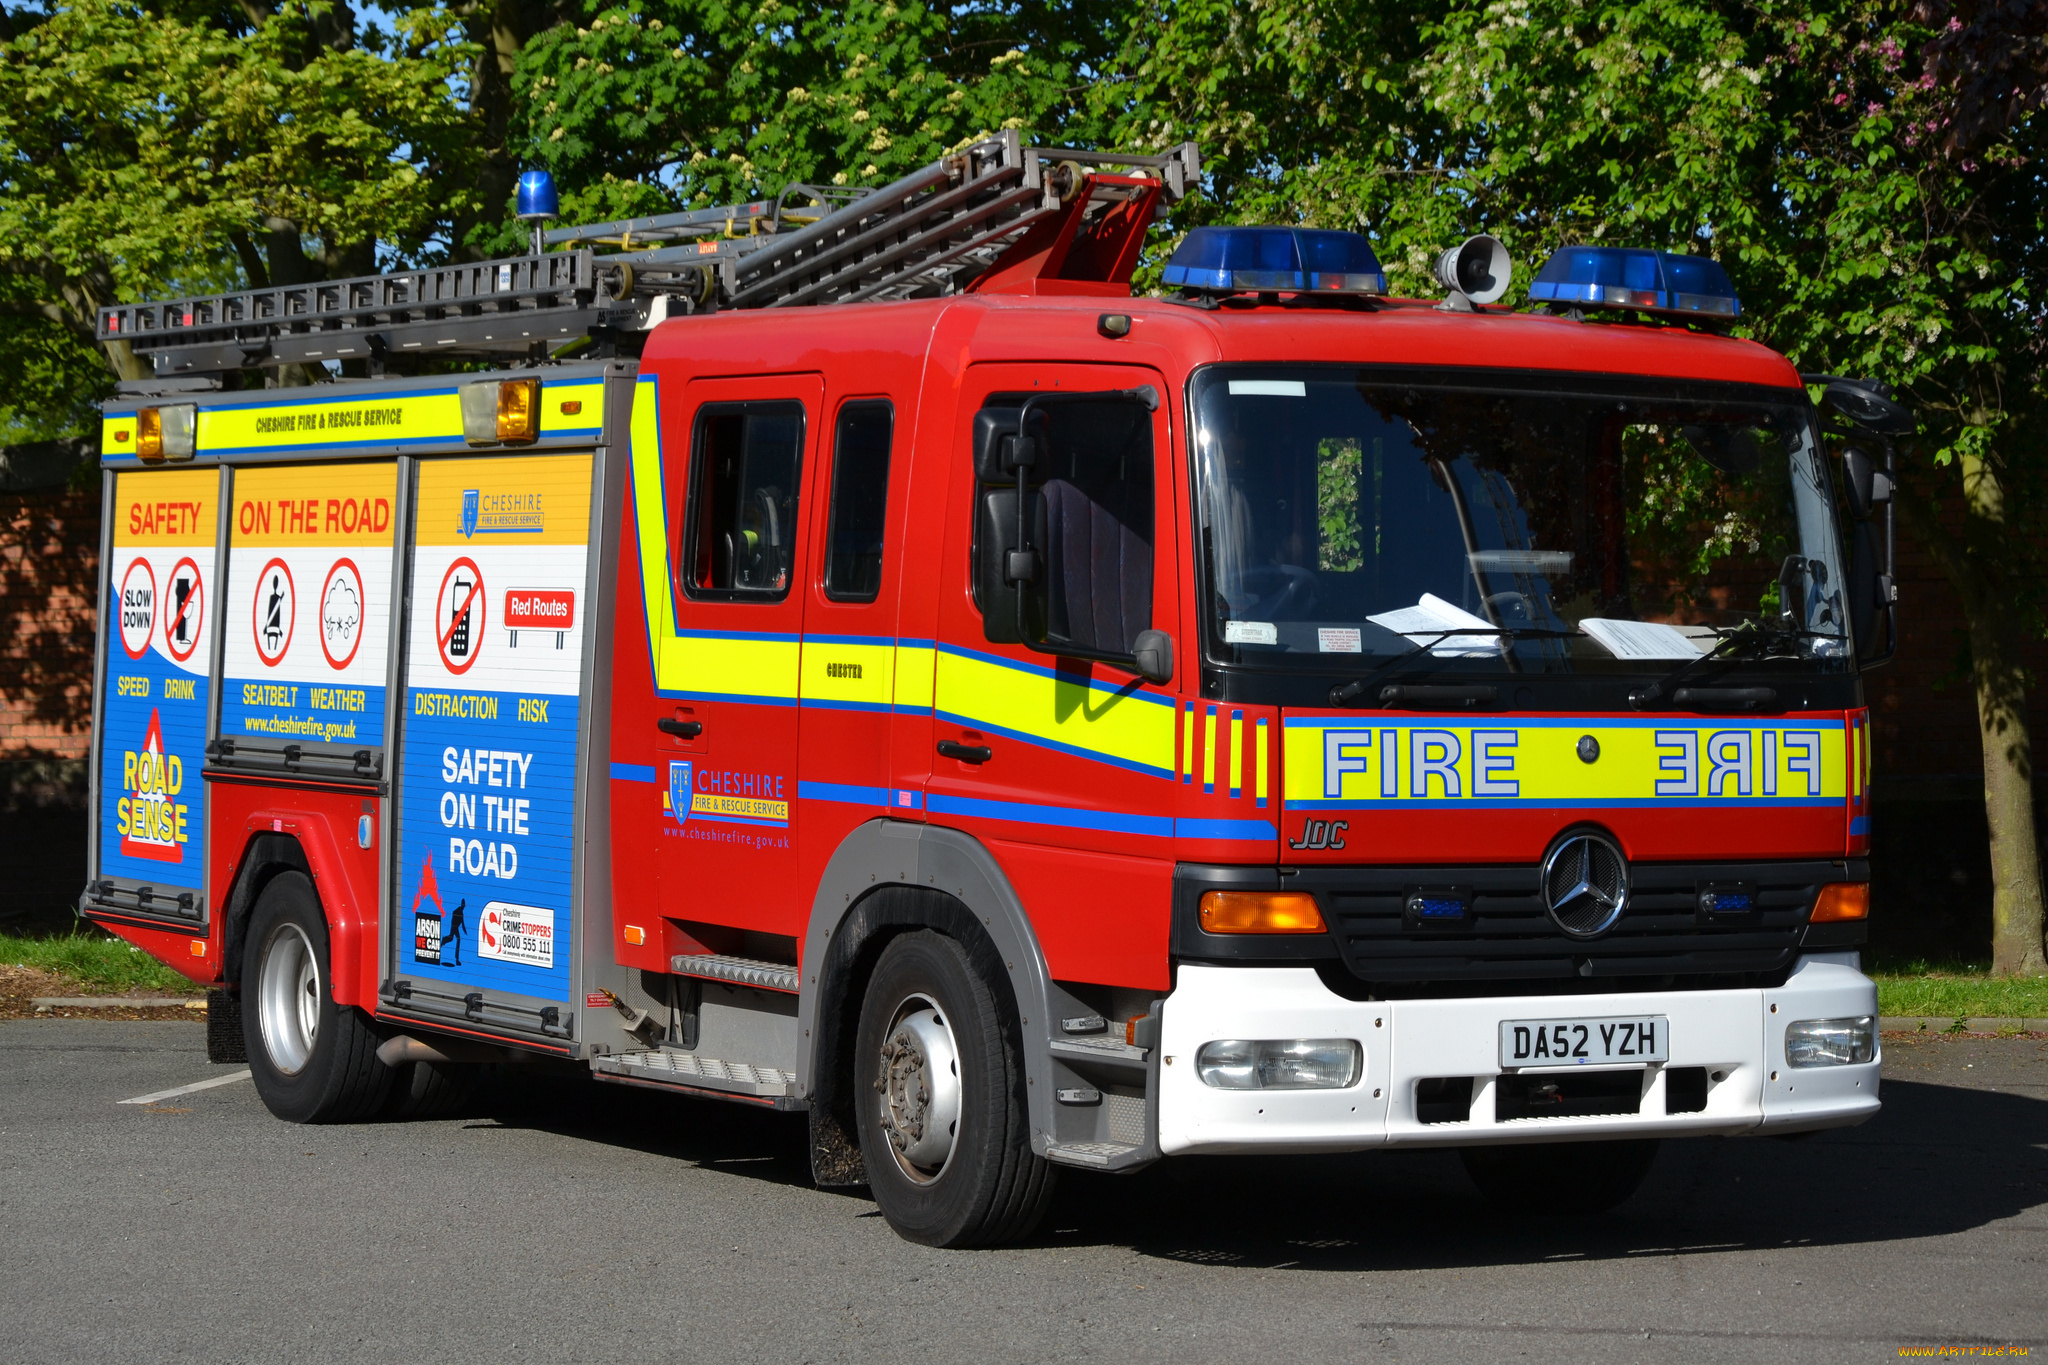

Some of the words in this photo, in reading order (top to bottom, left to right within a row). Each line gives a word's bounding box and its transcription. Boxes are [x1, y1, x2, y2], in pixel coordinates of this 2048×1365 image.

[256, 416, 296, 433] CHESHIRE
[298, 414, 316, 430] FIRE
[319, 413, 326, 429] &
[328, 410, 362, 428] RESCUE
[364, 408, 402, 426] SERVICE
[483, 494, 541, 511] CHESHIRE
[129, 502, 201, 535] SAFETY
[239, 501, 271, 535] ON
[278, 500, 318, 534] THE
[325, 498, 390, 534] ROAD
[481, 516, 493, 525] FIRE
[494, 516, 498, 525] &
[499, 515, 519, 525] RESCUE
[520, 515, 541, 525] SERVICE
[124, 589, 152, 607] SLOW
[511, 597, 531, 616] Red
[532, 597, 568, 617] Routes
[123, 611, 151, 629] DOWN
[827, 663, 862, 679] CHESTER
[117, 676, 150, 698] SPEED
[164, 678, 196, 700] DRINK
[242, 684, 298, 708] SEATBELT
[310, 687, 365, 712] WEATHER
[415, 693, 498, 719] DISTRACTION
[518, 698, 549, 723] RISK
[245, 714, 356, 742] www.cheshirefire.gov.uk
[122, 751, 183, 795] ROAD
[441, 746, 533, 789] SAFETY
[1322, 729, 1519, 799] FIRE
[698, 770, 784, 798] CHESHIRE
[440, 791, 476, 830] ON
[482, 796, 530, 836] THE
[695, 797, 711, 810] FIRE
[713, 799, 719, 810] &
[721, 799, 751, 813] RESCUE
[753, 802, 786, 816] SERVICE
[116, 797, 188, 843] SENSE
[664, 827, 789, 849] www.cheshirefire.gov.uk
[1289, 817, 1349, 850] JDC
[449, 837, 518, 880] ROAD
[503, 908, 521, 918] Cheshire
[416, 918, 440, 939] ARSON
[503, 920, 552, 938] CRIMESTOPPERS
[416, 936, 427, 949] WE
[426, 938, 440, 951] CAN
[416, 949, 435, 959] PREVENT
[503, 934, 521, 950] 0800
[522, 938, 537, 952] 555
[539, 941, 551, 955] 111
[1514, 1025, 1589, 1059] DA52
[1600, 1022, 1655, 1056] YZH
